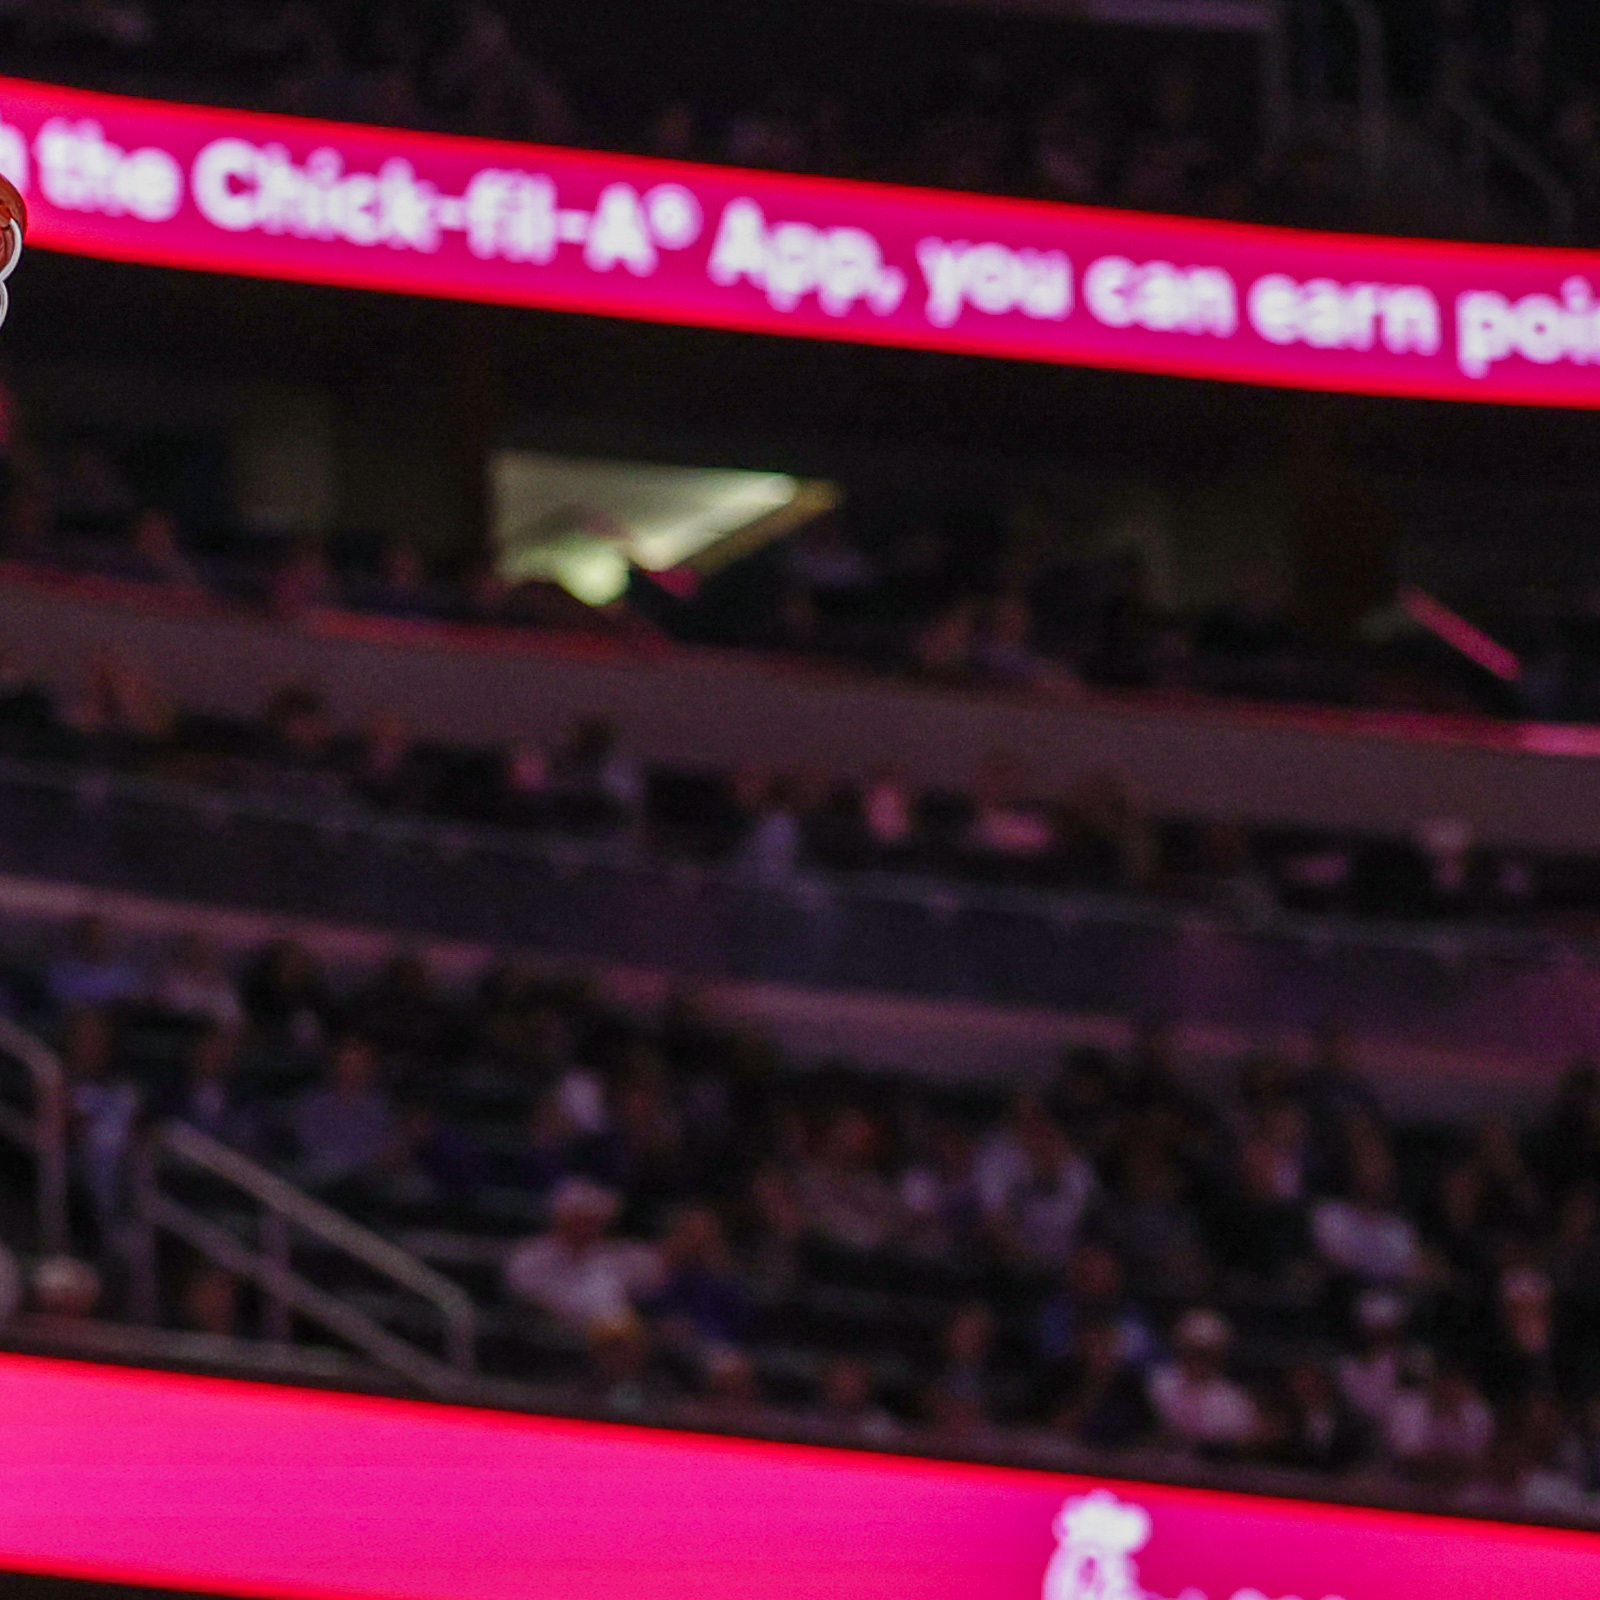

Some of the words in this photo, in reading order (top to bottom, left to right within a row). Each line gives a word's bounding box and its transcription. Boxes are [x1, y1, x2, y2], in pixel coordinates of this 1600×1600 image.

[33, 118, 183, 222] the
[706, 196, 908, 318] App,
[915, 235, 1074, 329] you
[1083, 254, 1240, 339] can
[1246, 272, 1443, 357] earn
[1455, 275, 1600, 380] poi
